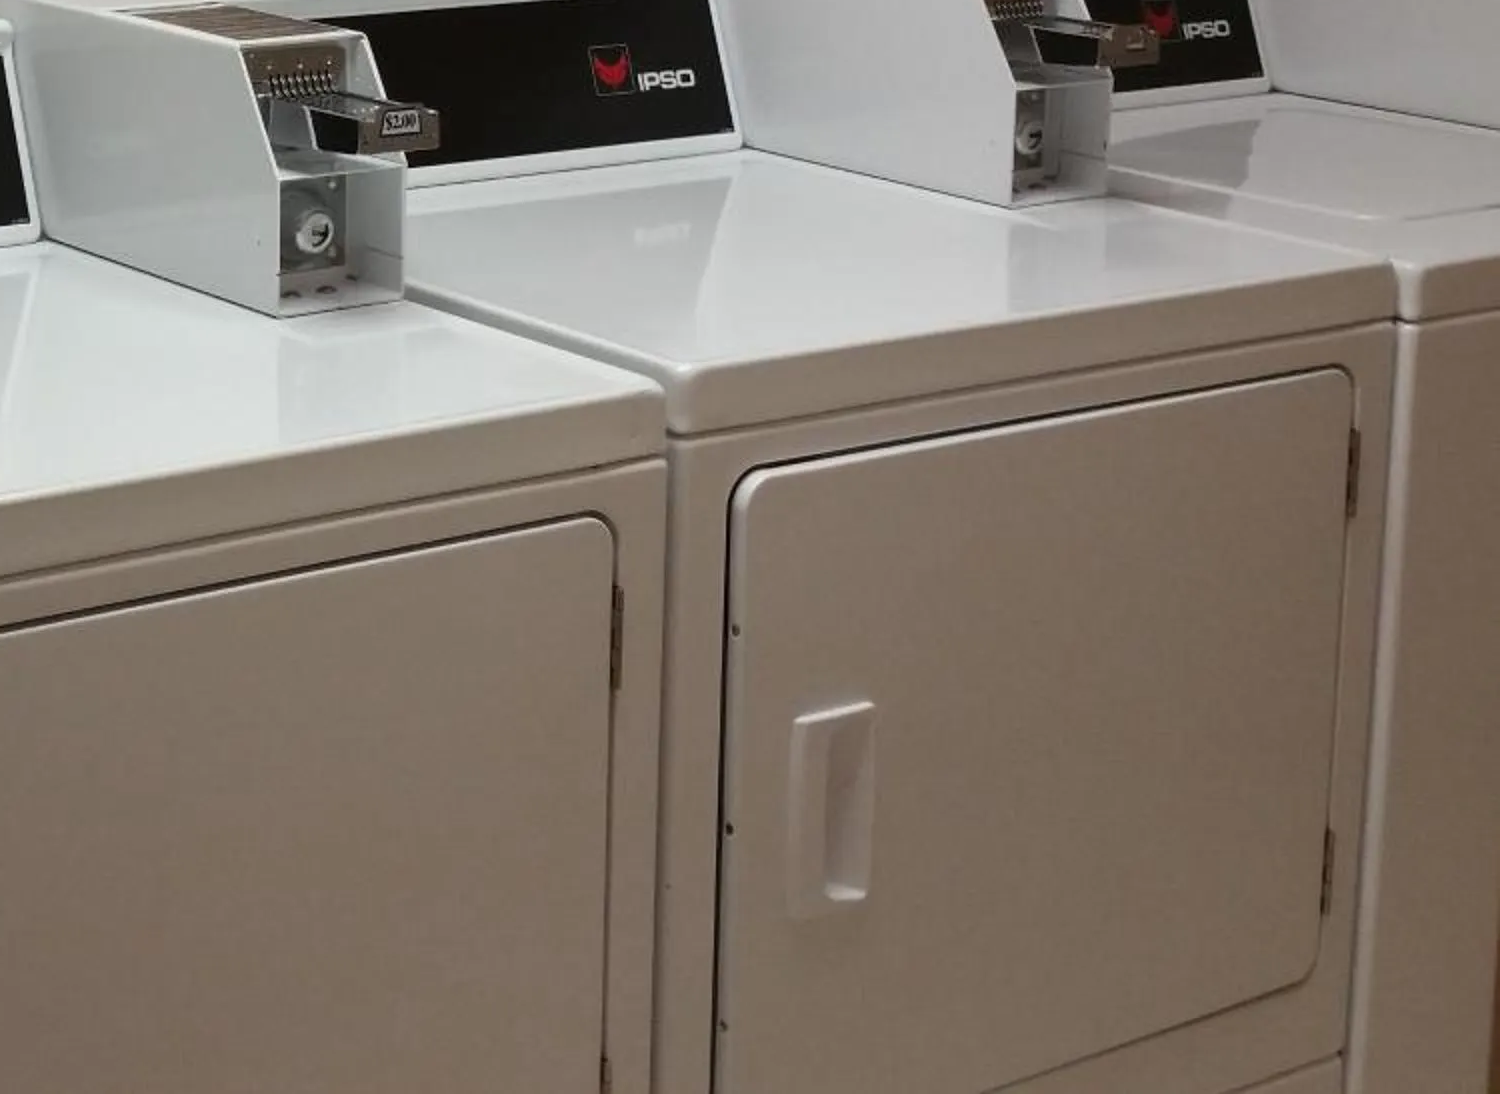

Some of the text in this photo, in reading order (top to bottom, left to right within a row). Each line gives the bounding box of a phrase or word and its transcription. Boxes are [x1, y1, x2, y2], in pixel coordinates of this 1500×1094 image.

[1181, 20, 1230, 40] IPSO
[637, 69, 695, 92] IPSO
[385, 113, 417, 131] $2.00
